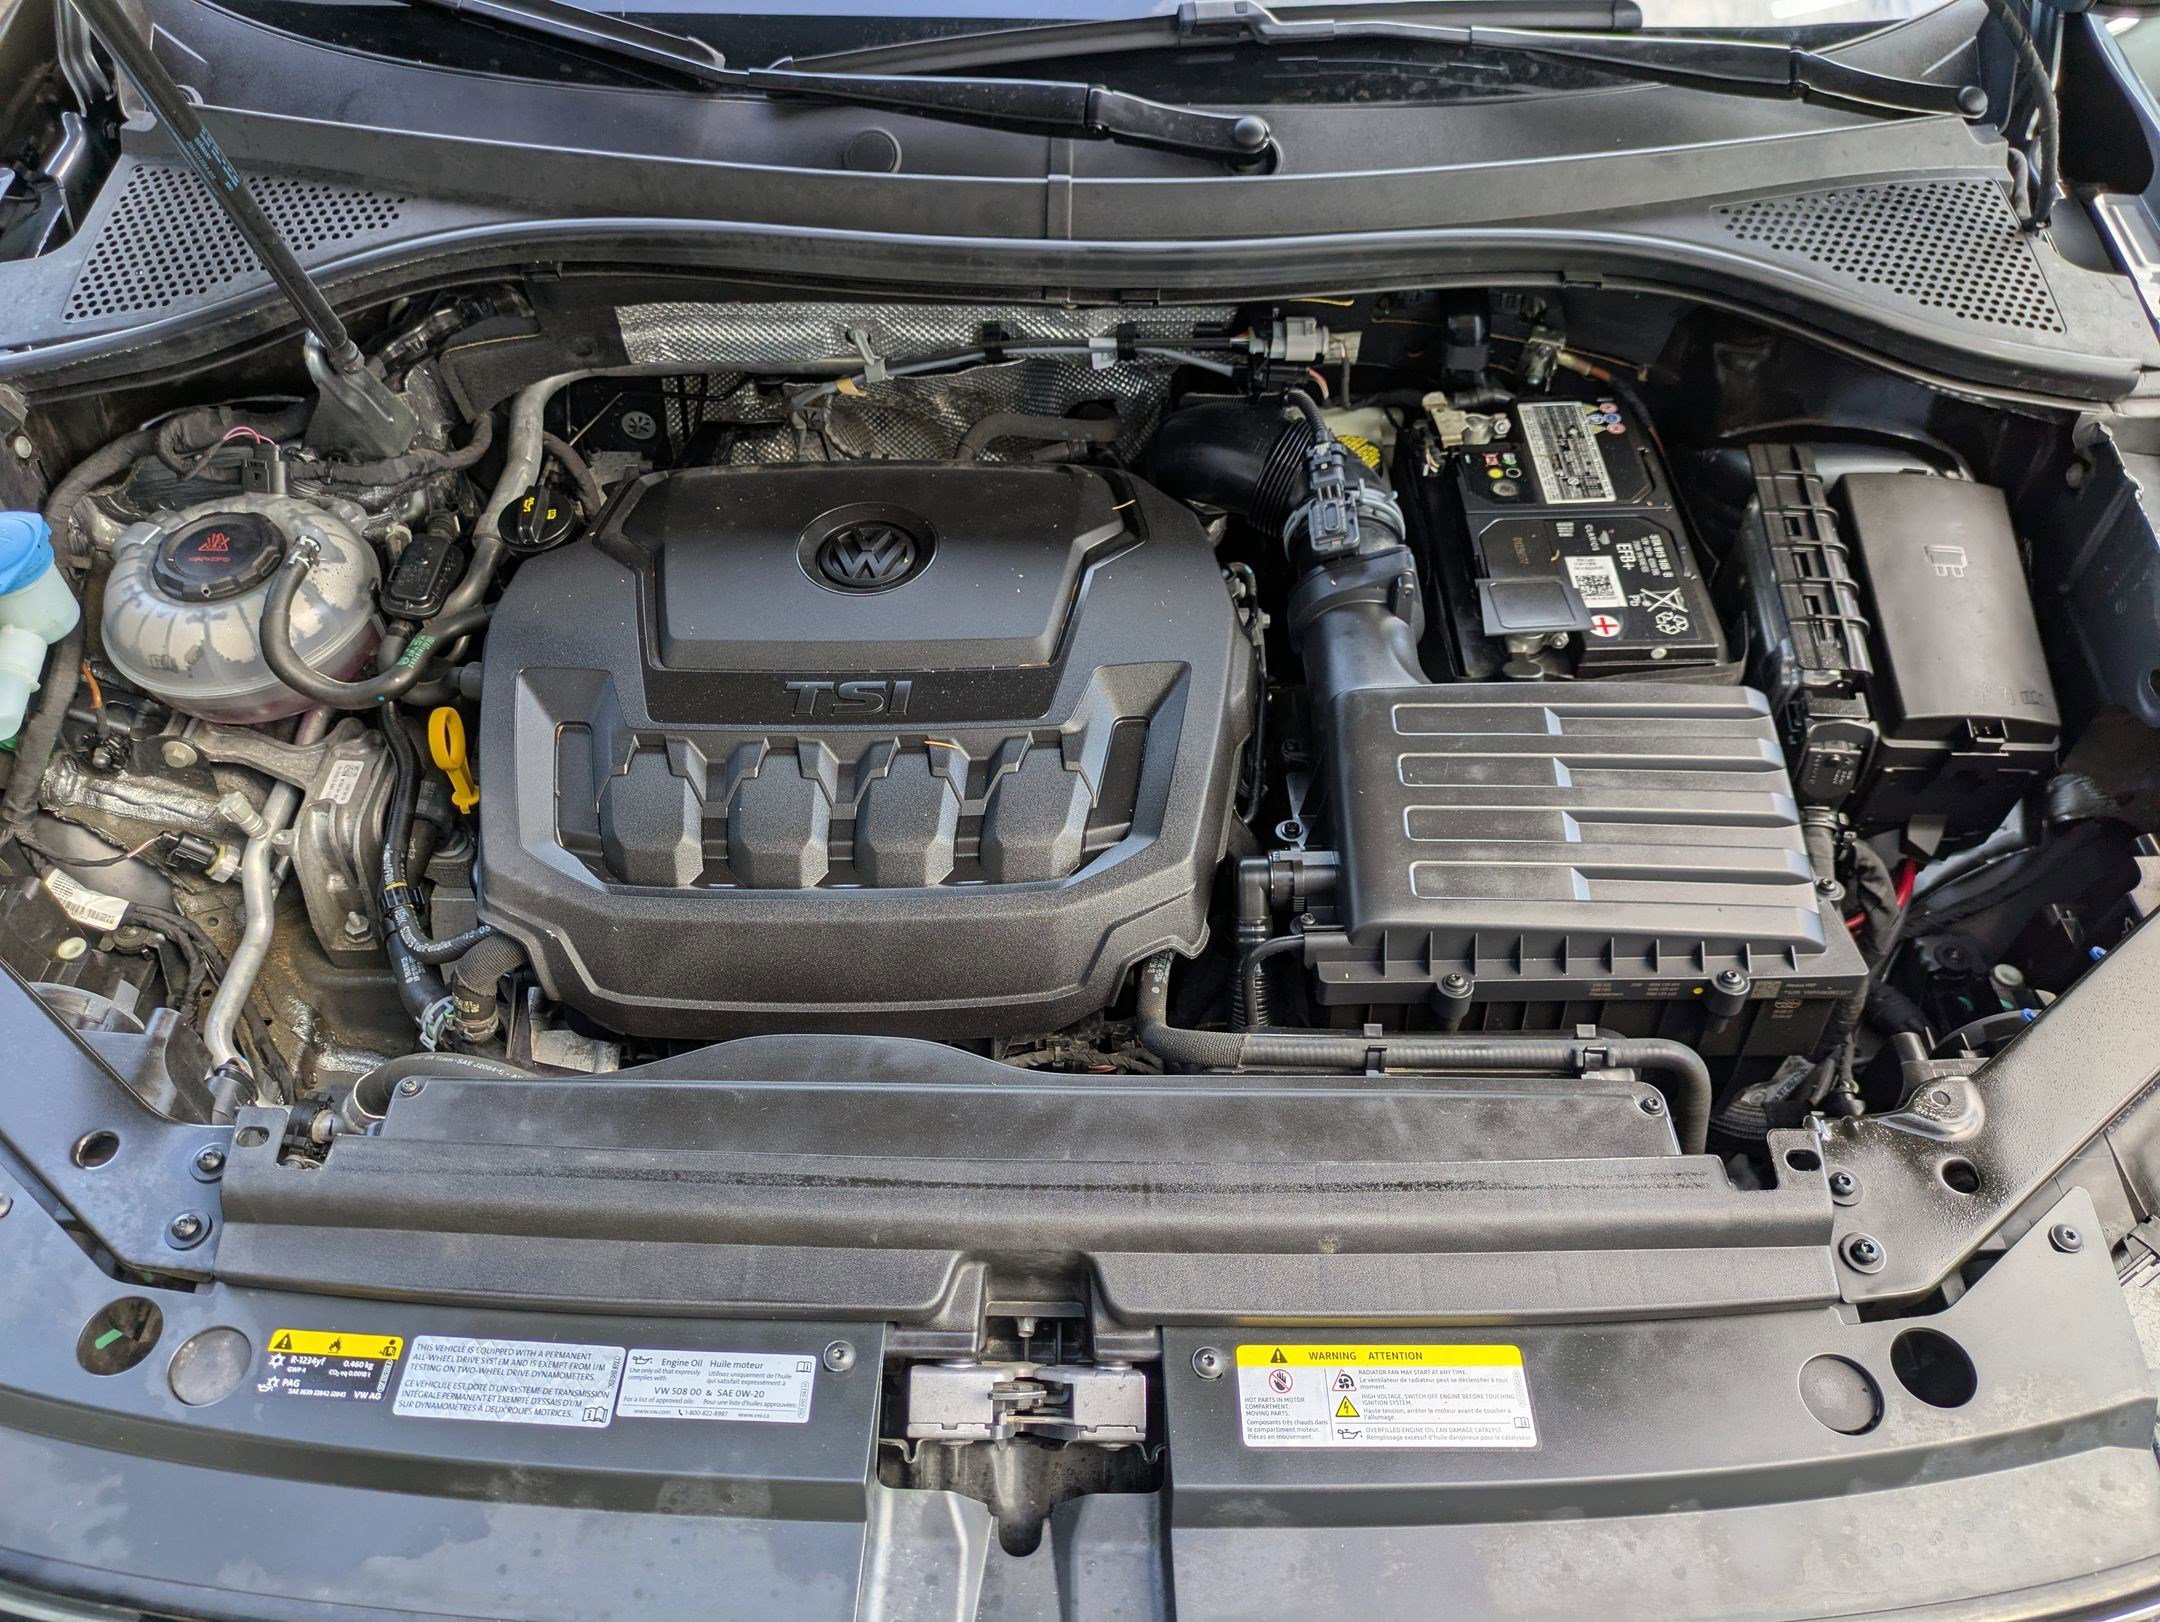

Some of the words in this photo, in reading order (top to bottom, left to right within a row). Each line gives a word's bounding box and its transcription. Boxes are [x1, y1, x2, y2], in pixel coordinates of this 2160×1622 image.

[1584, 524, 1600, 551] CLARIOS
[824, 525, 912, 583] VW
[1616, 543, 1636, 570] EFB+
[1628, 594, 1641, 606] Pb
[784, 680, 912, 716] TSI
[435, 1344, 465, 1353] VEHICLE
[476, 1347, 514, 1356] EQUIPPED
[545, 1351, 592, 1360] PERMANENT
[1309, 1352, 1357, 1360] WARNING
[1368, 1352, 1423, 1360] ATTENTION
[290, 1356, 327, 1367] R-1234yf
[343, 1360, 364, 1368] 0.460
[365, 1362, 374, 1371] kg
[413, 1354, 455, 1363] ALL-WHEEL
[456, 1355, 479, 1364] DRIVE
[480, 1357, 509, 1366] SYSTEM
[538, 1360, 567, 1369] EXEMPT
[569, 1362, 591, 1370] FROM
[661, 1358, 689, 1368] Engine
[710, 1360, 731, 1368] Huile
[411, 1363, 441, 1372] TESTING
[458, 1365, 504, 1375] TWO-WHEEL
[507, 1369, 531, 1377] DRIVE
[532, 1370, 595, 1381] DYNAMOMETERS.
[282, 1378, 301, 1388] PAG
[404, 1379, 415, 1387] CE
[416, 1379, 451, 1389] VÉHICULE
[452, 1381, 466, 1390] EST
[467, 1382, 487, 1391] DOTÉ
[489, 1384, 508, 1392] D'UN
[554, 1388, 610, 1398] TRANSMISSION
[354, 1391, 368, 1399] VW
[368, 1392, 381, 1400] AG
[402, 1389, 440, 1399] INTÉGRALE
[442, 1392, 486, 1401] PERMANENT
[498, 1394, 528, 1404] EXEMPTÉ
[531, 1397, 561, 1406] D'ESSAIS
[735, 1390, 765, 1398] 0W-20
[508, 1406, 532, 1415] ROUES
[534, 1408, 573, 1417] MOTRICES.
